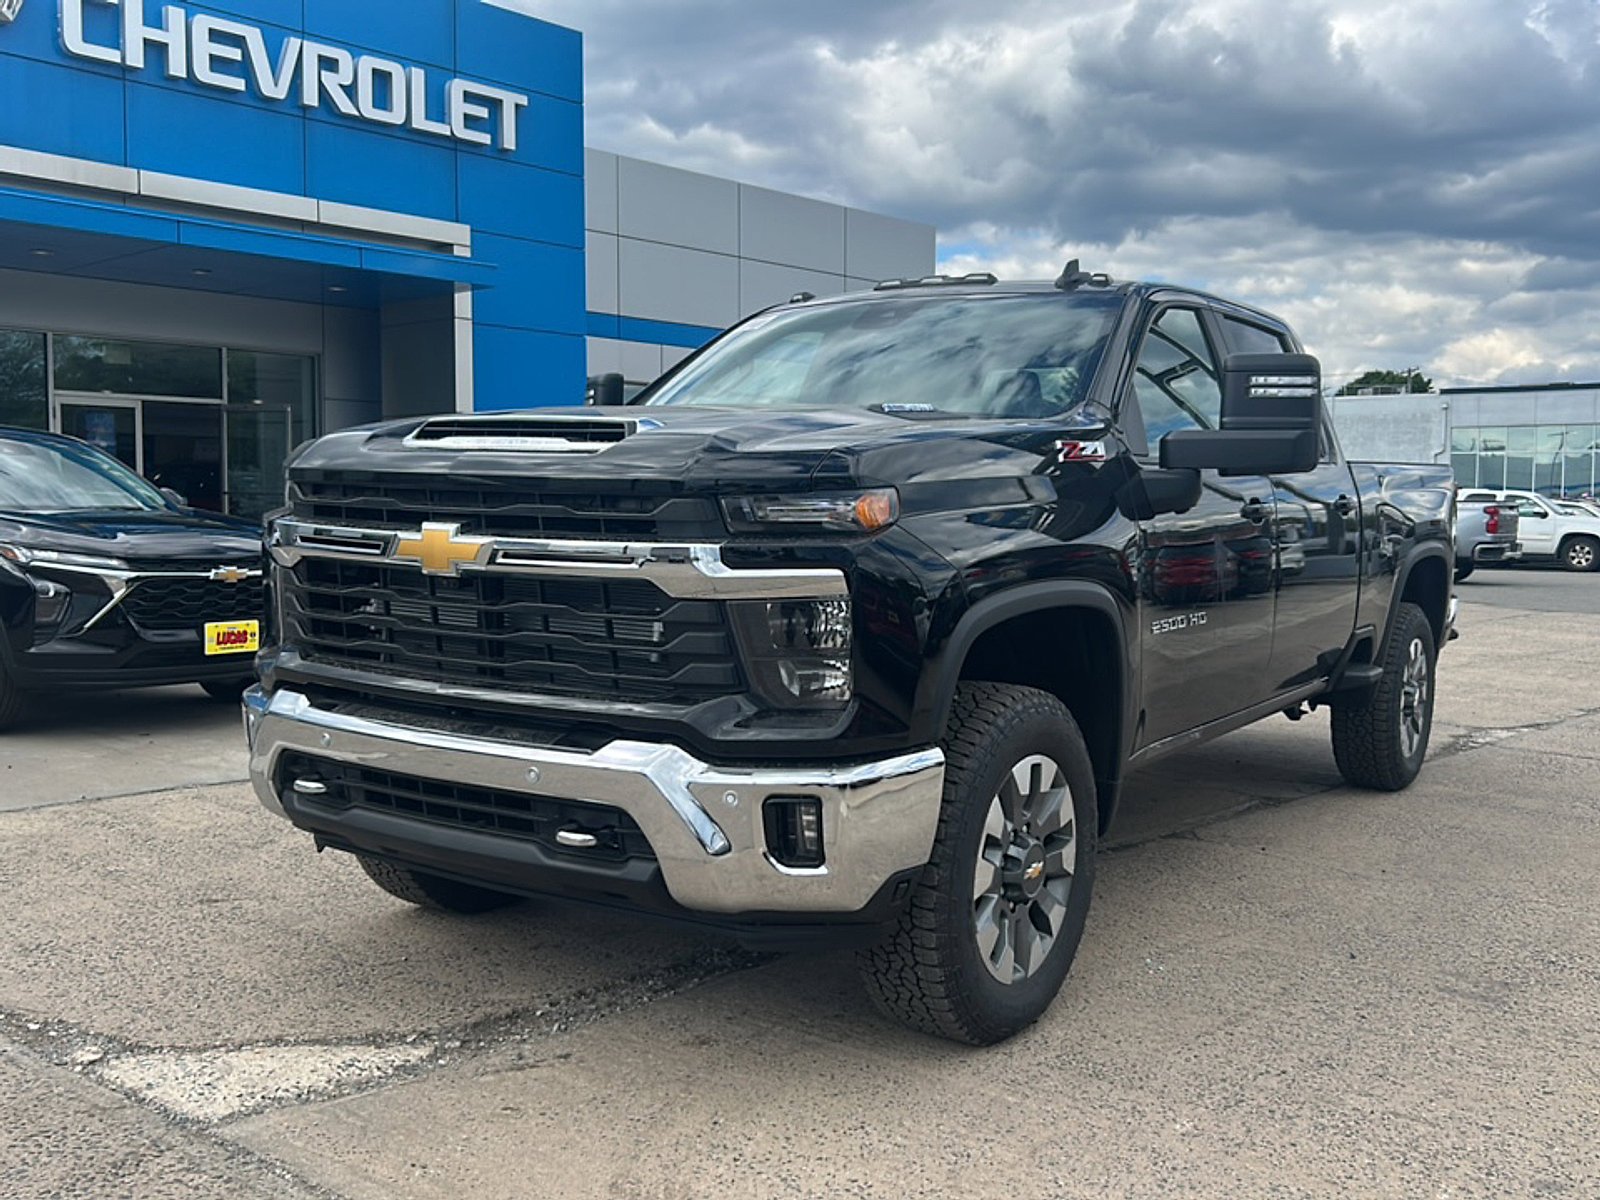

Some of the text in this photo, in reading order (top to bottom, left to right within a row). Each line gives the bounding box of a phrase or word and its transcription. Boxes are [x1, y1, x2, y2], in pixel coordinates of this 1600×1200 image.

[57, 0, 528, 151] CHEVROLET
[1151, 611, 1207, 634] 2500 HD
